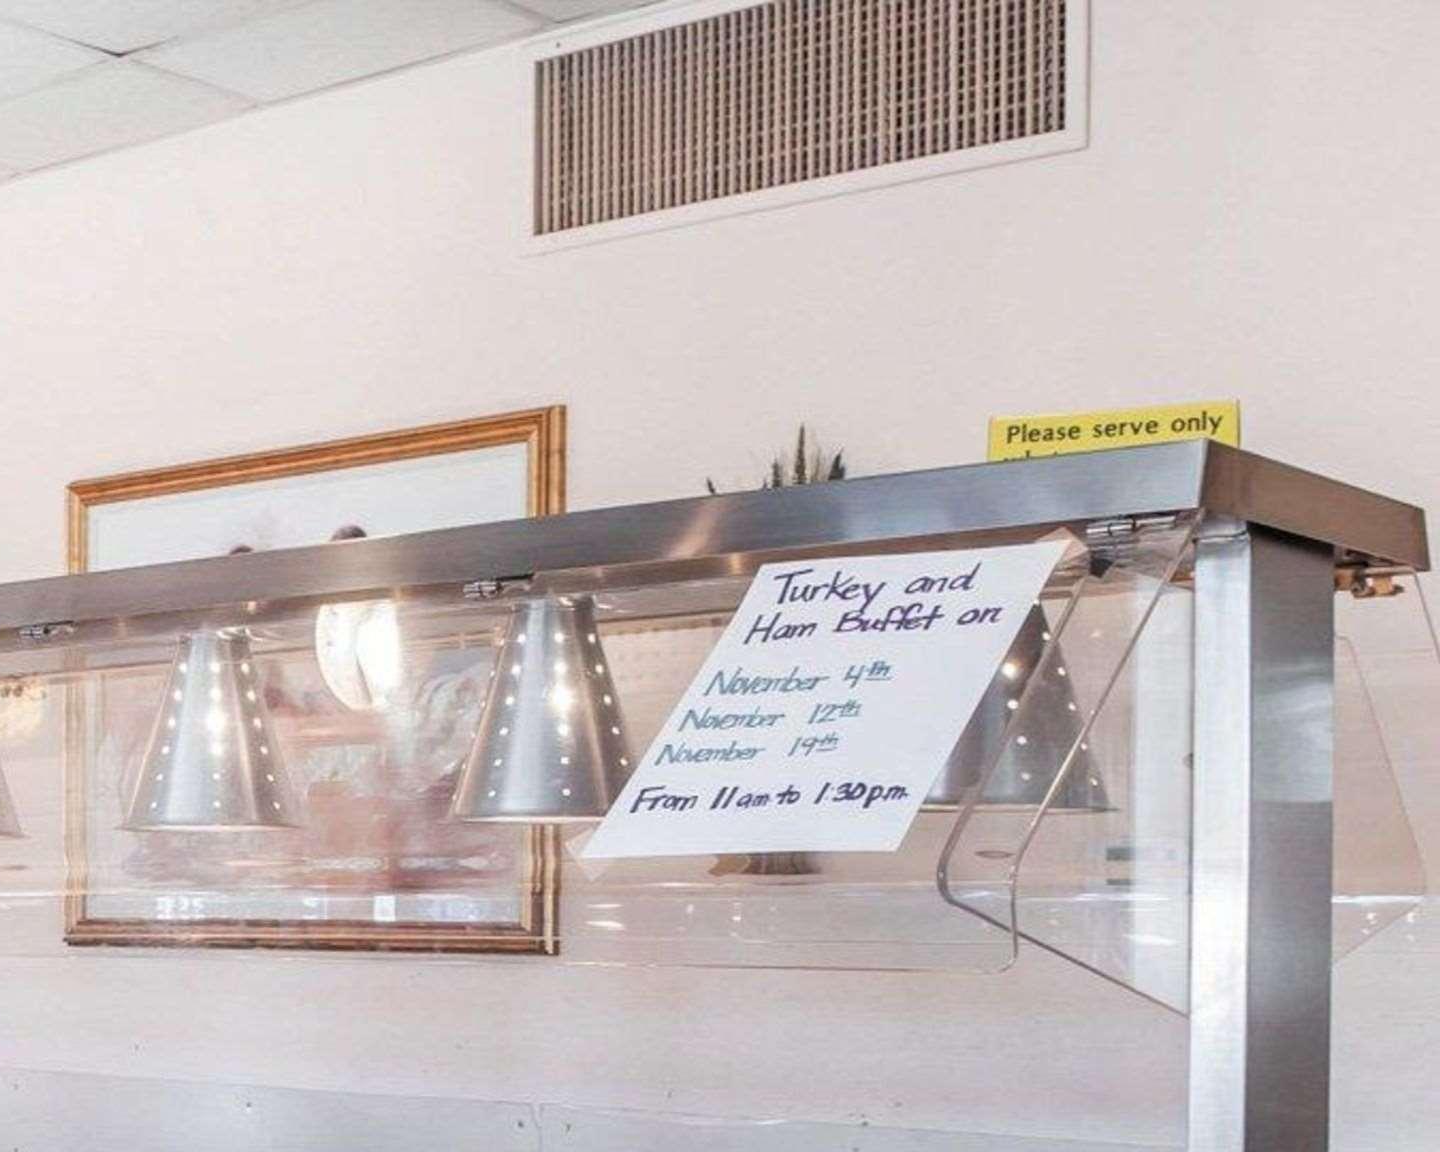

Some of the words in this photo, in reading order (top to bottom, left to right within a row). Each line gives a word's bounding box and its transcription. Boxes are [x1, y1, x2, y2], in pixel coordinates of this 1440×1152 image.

[1006, 423, 1081, 444] Please
[1092, 417, 1159, 438] serve
[1170, 411, 1223, 436] only
[773, 568, 886, 610] Turkey
[904, 562, 982, 595] and
[744, 612, 818, 645] Ham
[832, 602, 944, 633] Buffet
[957, 606, 1003, 626] on
[703, 665, 830, 697] November
[843, 660, 892, 689] 4th
[678, 705, 786, 733] November
[808, 699, 862, 725] 12th
[654, 740, 766, 767] November
[787, 731, 840, 758] 19th
[629, 785, 699, 814] From
[776, 784, 802, 805] to
